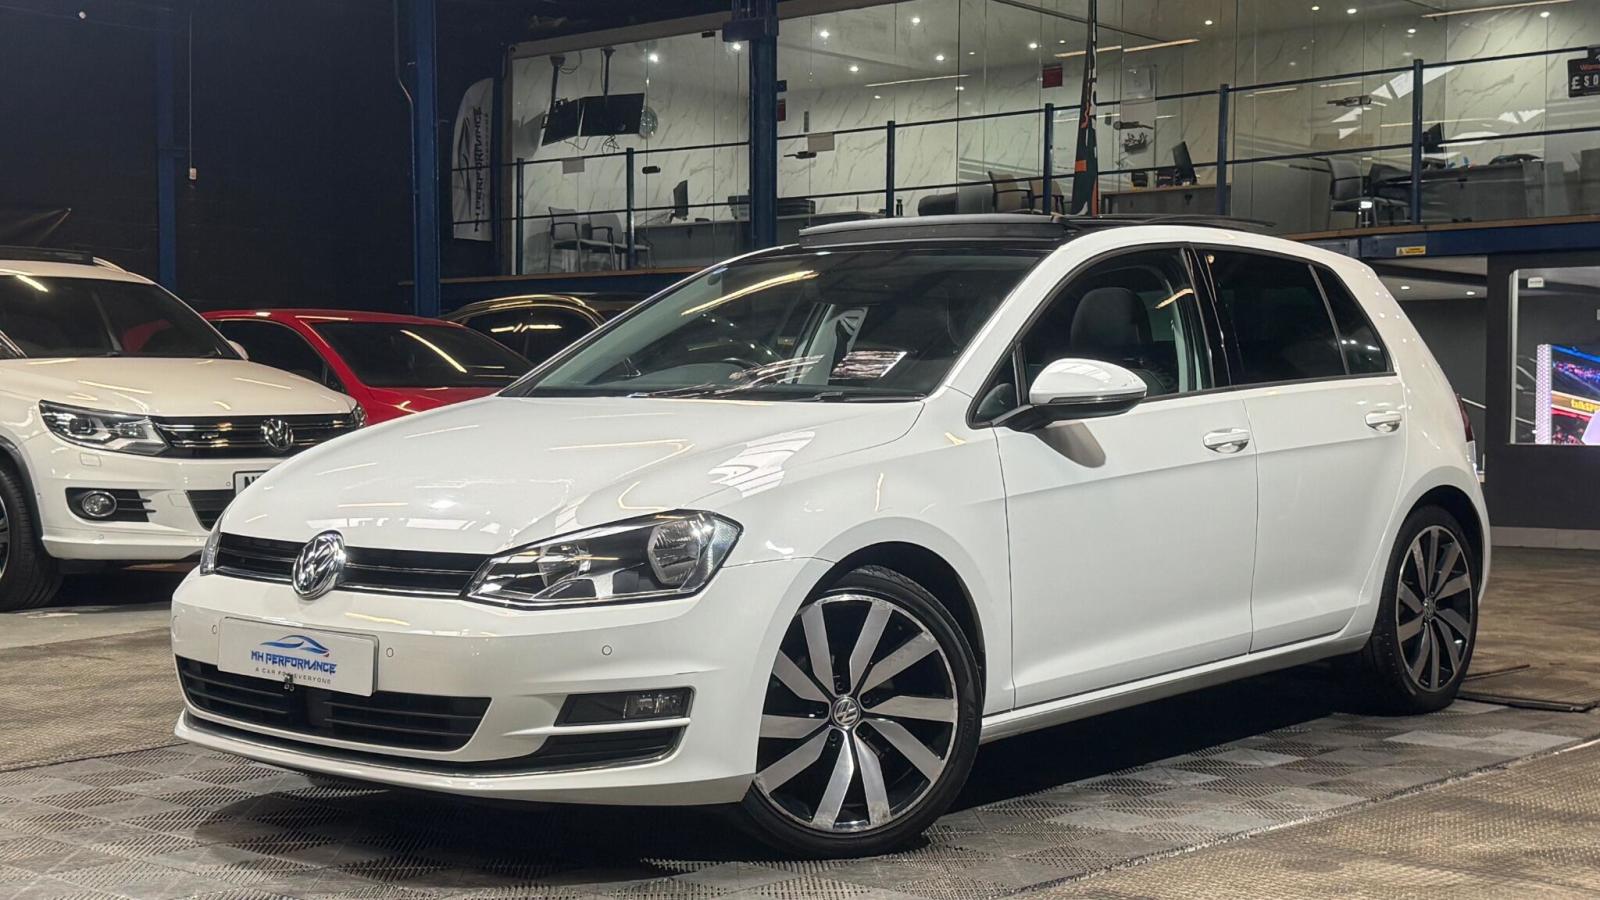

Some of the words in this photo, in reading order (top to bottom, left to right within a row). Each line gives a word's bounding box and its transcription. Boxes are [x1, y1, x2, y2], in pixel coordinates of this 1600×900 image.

[251, 650, 265, 662] MH
[265, 653, 337, 675] PERFORMANCE
[293, 673, 332, 685] EVERYONE
